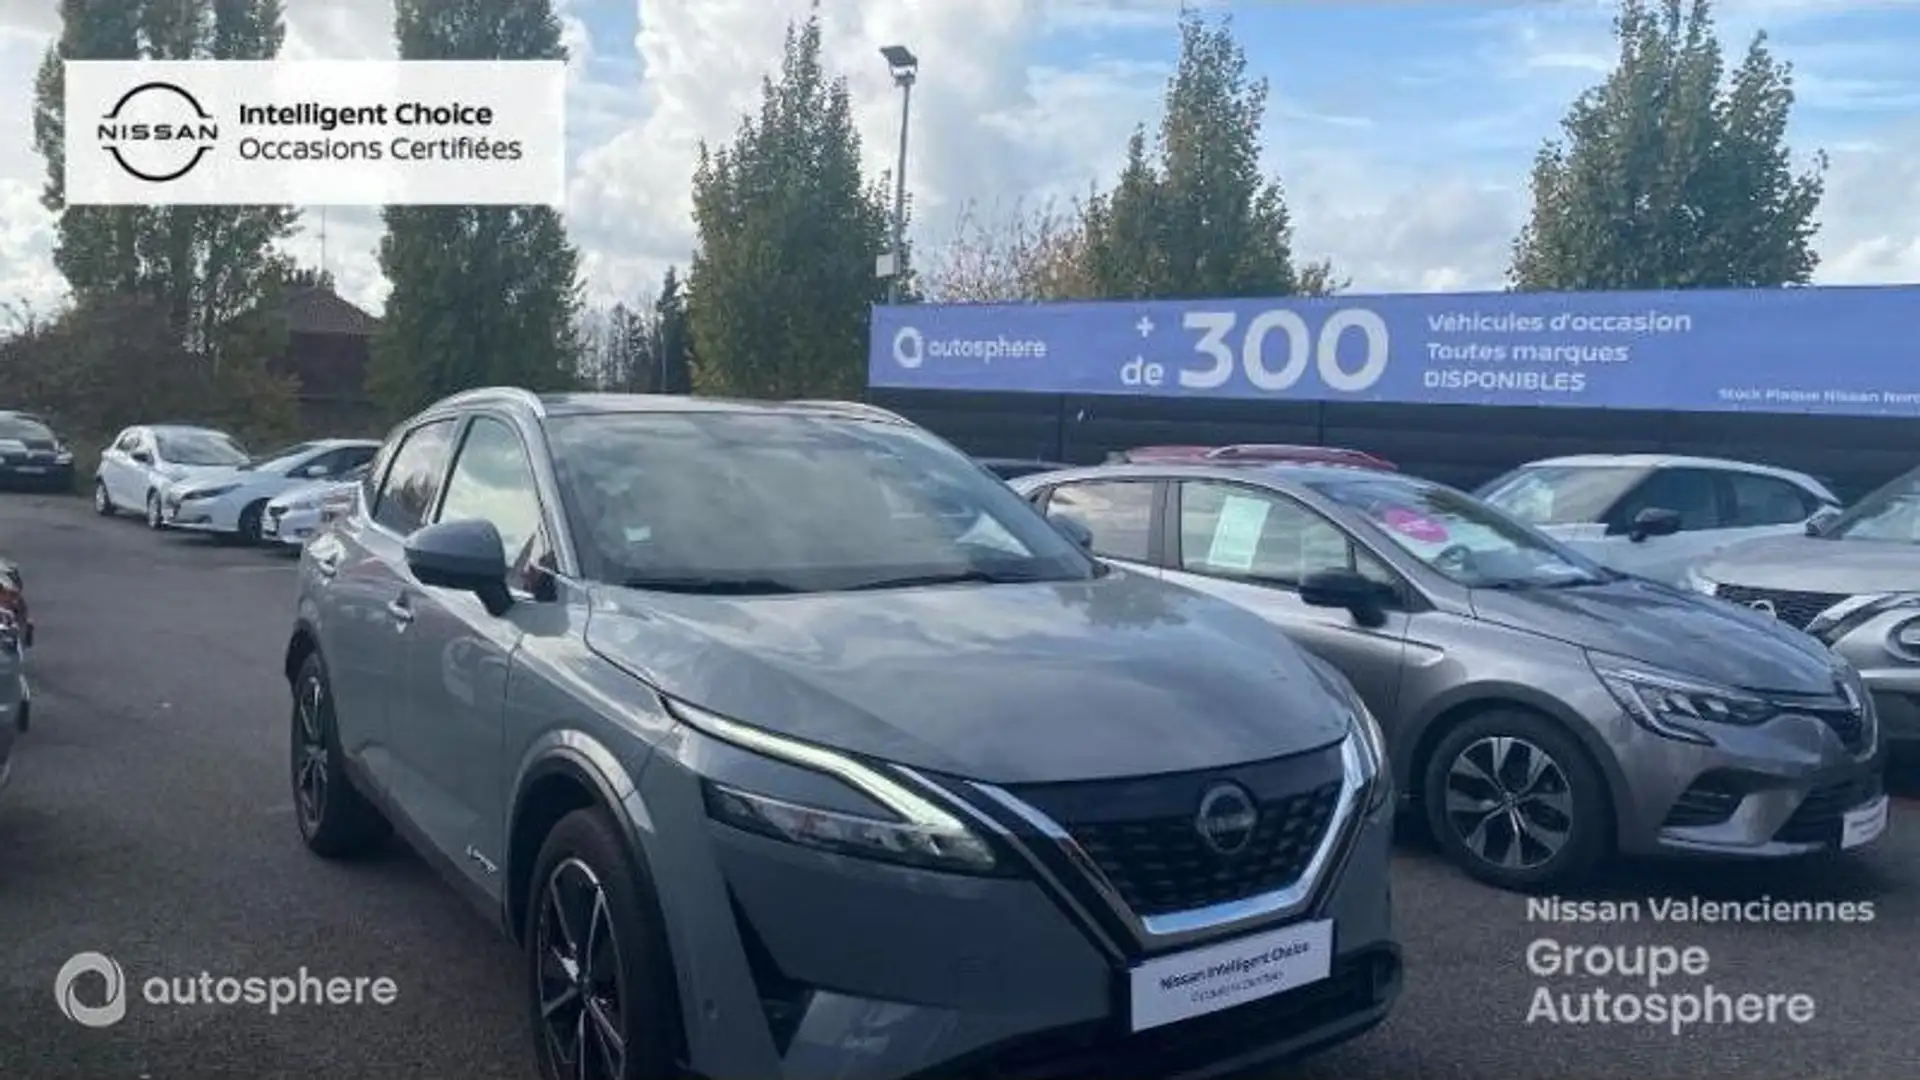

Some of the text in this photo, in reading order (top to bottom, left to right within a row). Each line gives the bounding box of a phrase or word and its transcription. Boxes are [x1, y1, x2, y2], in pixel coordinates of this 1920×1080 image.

[1427, 309, 1692, 333] Véhicules d'occasion
[928, 338, 1047, 365] autosphere
[1120, 309, 1390, 392] de 300
[1427, 342, 1629, 365] Toutes marques
[1423, 369, 1586, 392] DISPONIBLES
